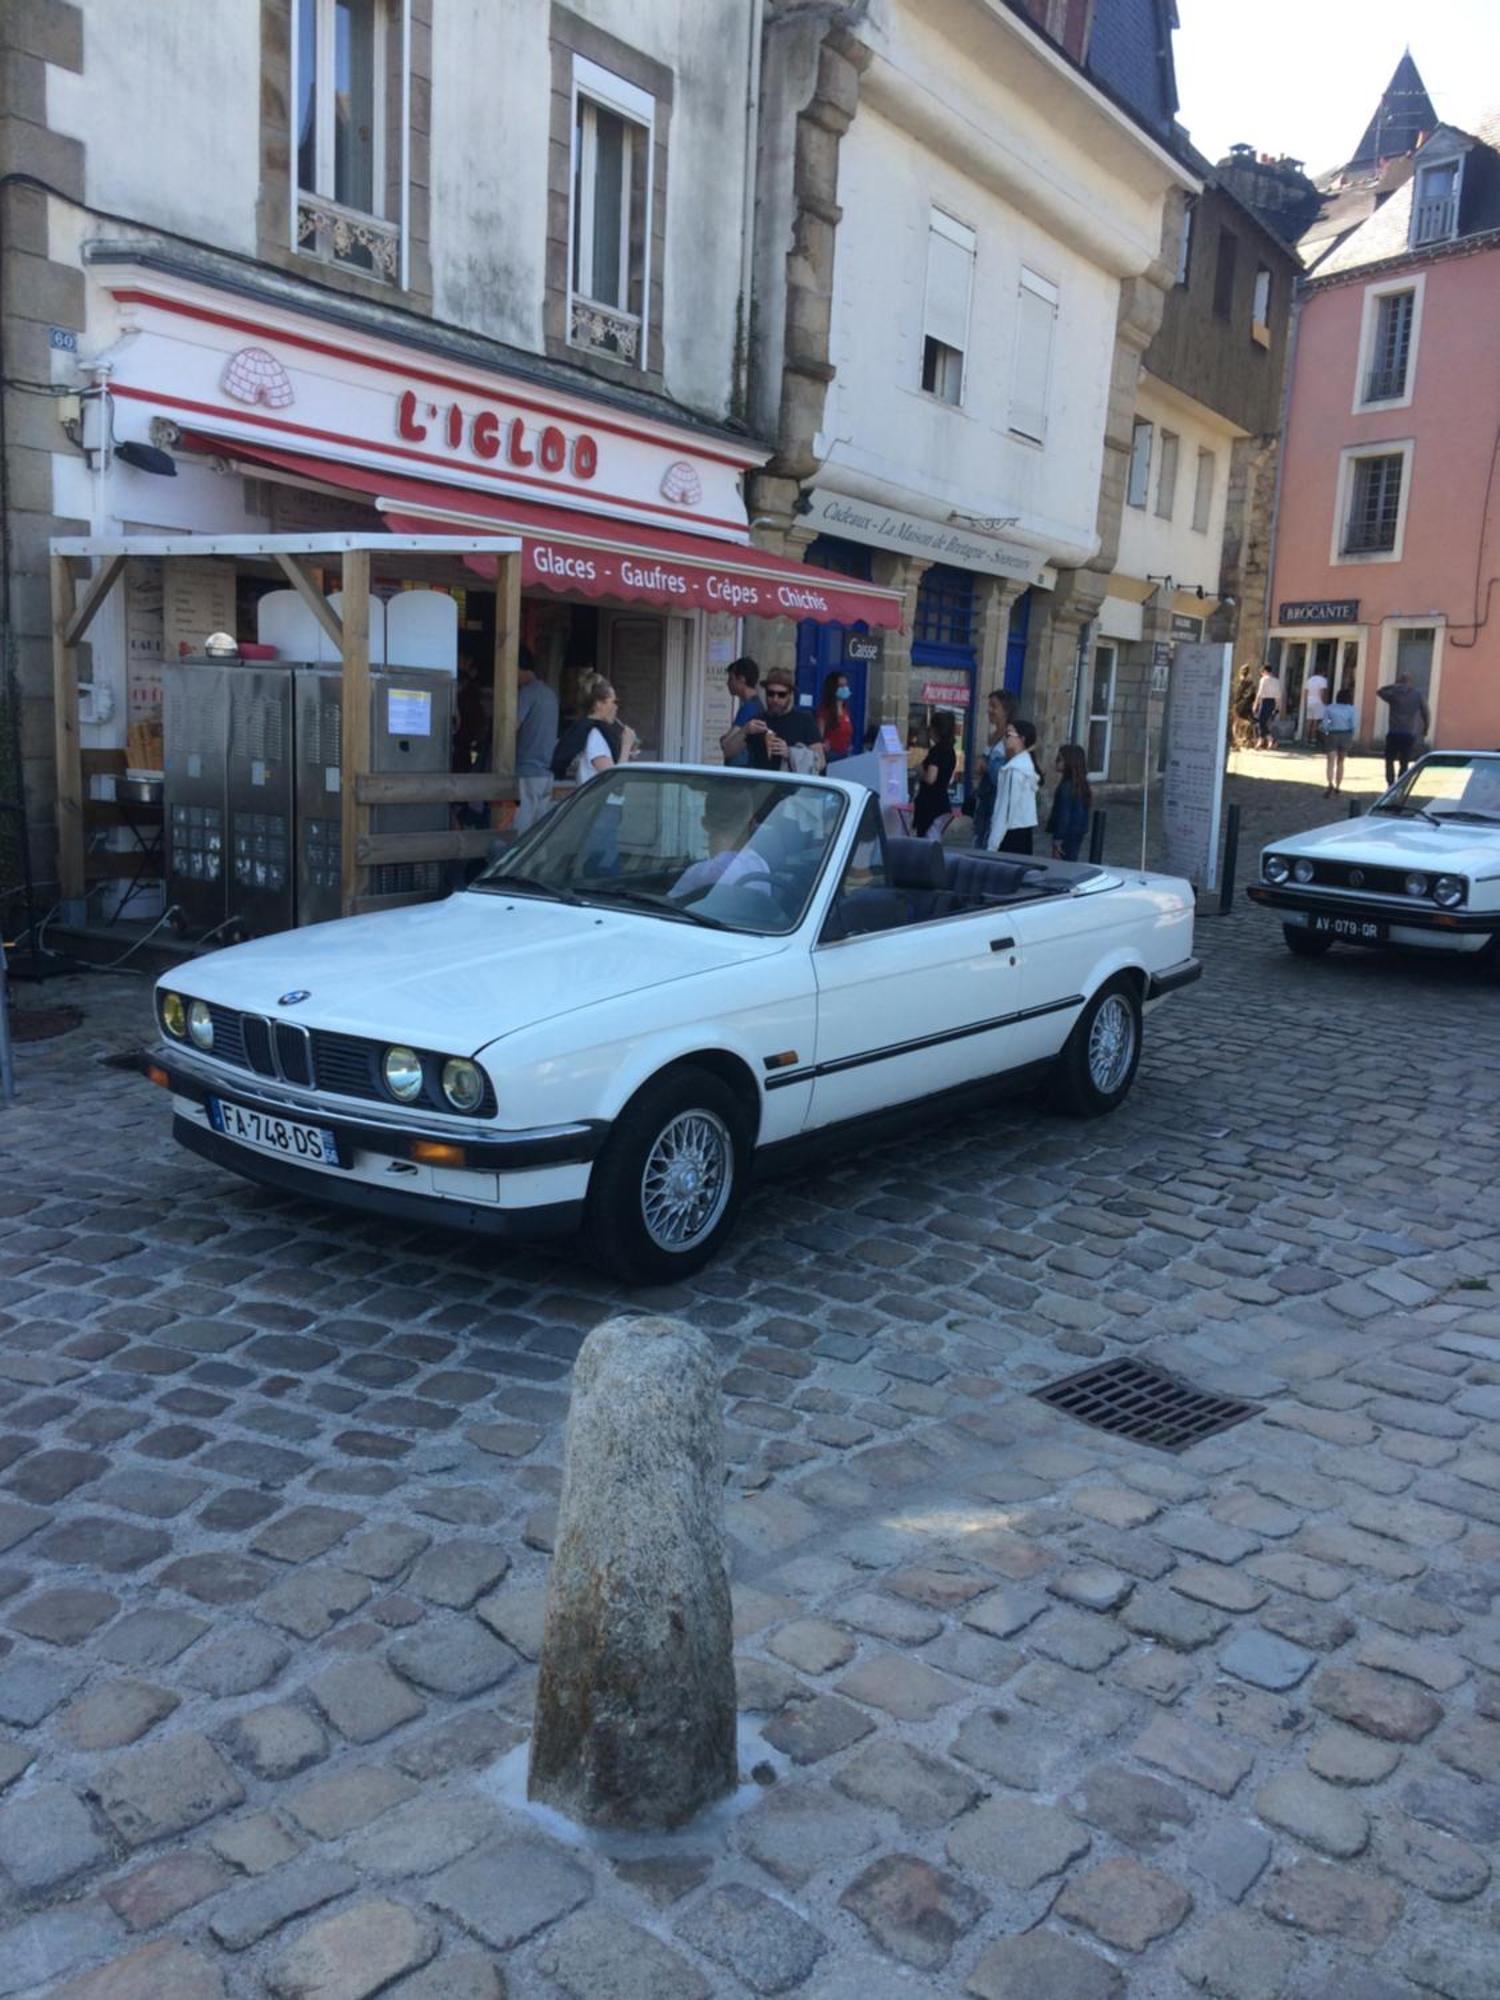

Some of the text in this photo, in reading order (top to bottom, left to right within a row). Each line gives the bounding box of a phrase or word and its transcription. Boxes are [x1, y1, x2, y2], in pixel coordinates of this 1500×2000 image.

[55, 331, 74, 348] 60
[399, 389, 598, 480] L'IGLOO
[822, 501, 871, 530] Cadeaux
[878, 517, 894, 536] La
[895, 521, 932, 549] Maison
[932, 532, 947, 549] de
[533, 546, 596, 580] Glaces
[620, 561, 687, 593] Gaufres
[706, 575, 759, 607] Crêpes
[777, 586, 828, 611] Chichis
[1285, 604, 1353, 620] BROCANTE
[848, 636, 878, 660] Caisse
[221, 1103, 323, 1159] FA-748-DS
